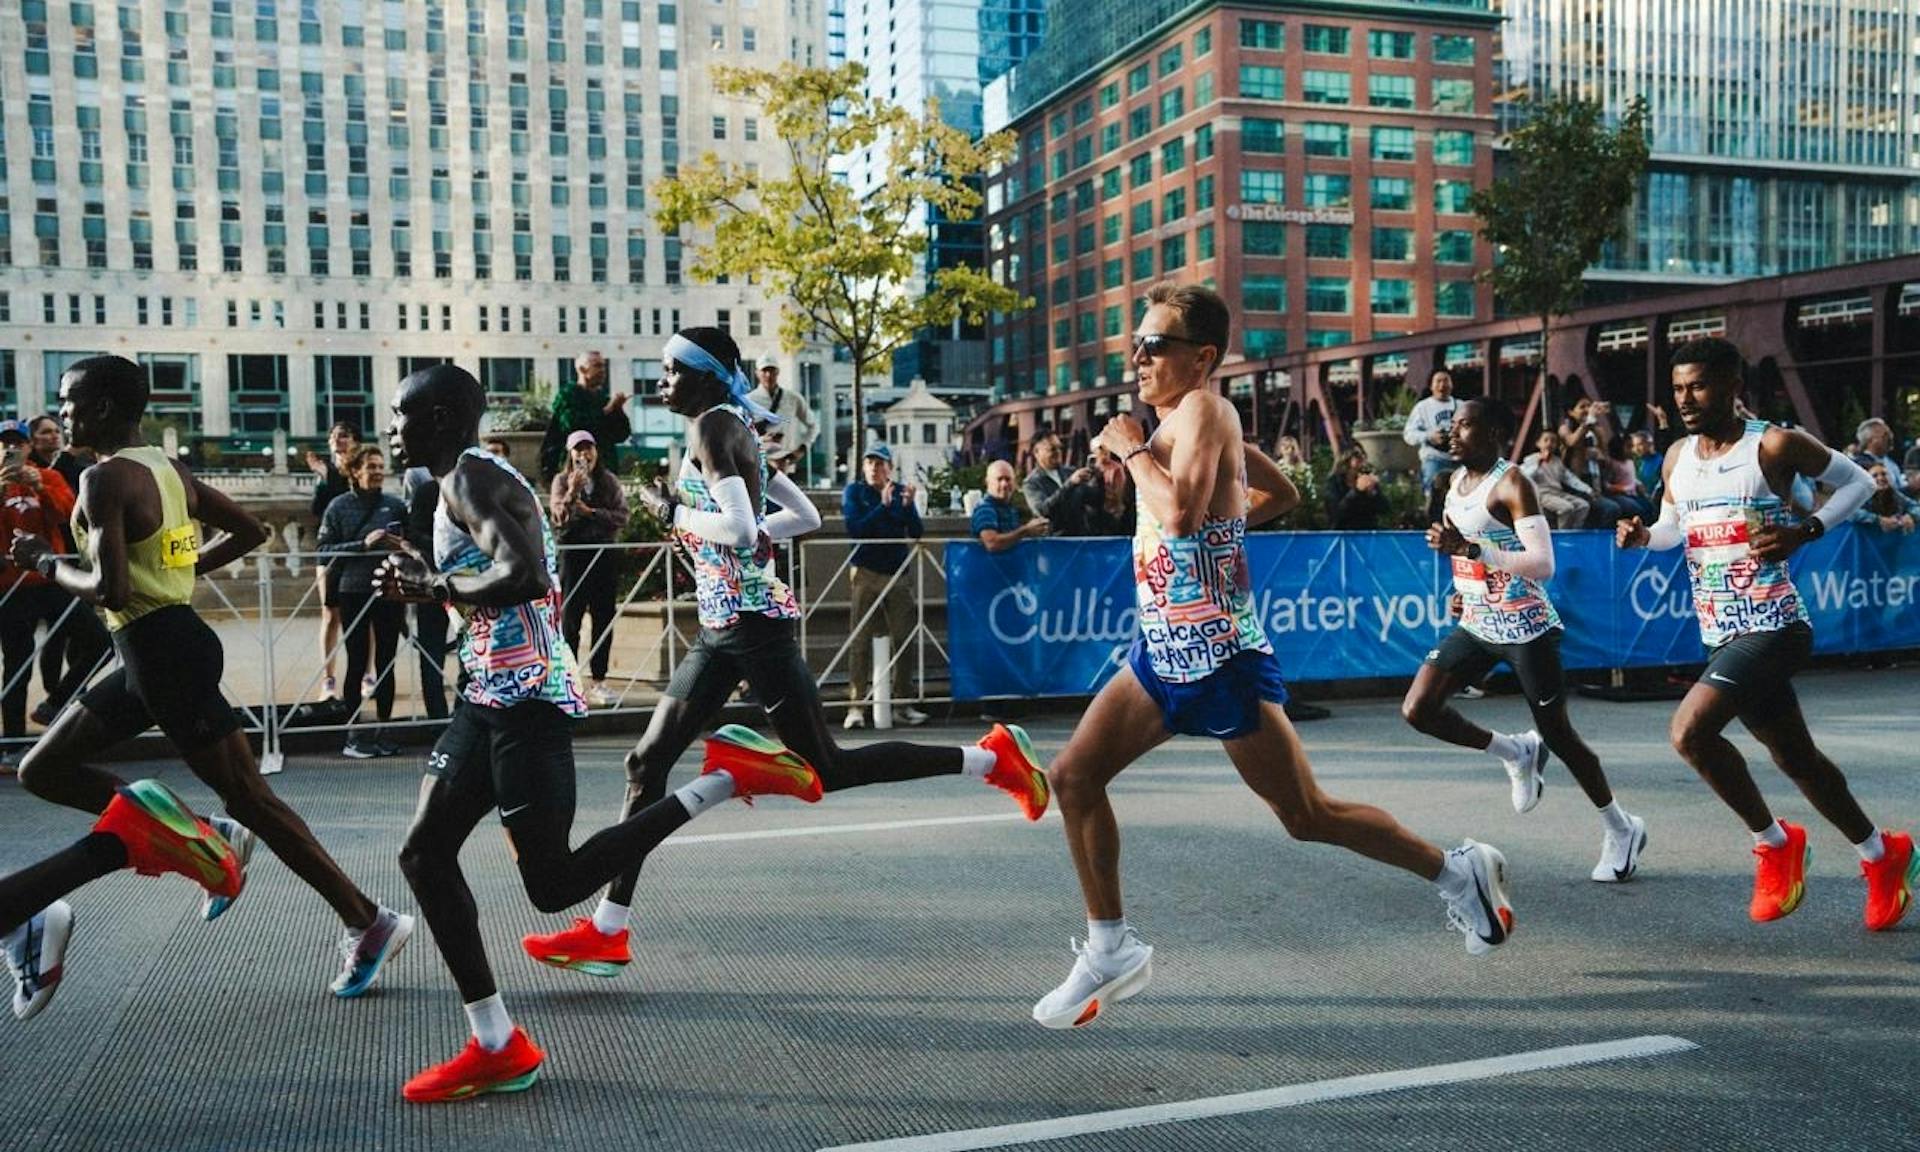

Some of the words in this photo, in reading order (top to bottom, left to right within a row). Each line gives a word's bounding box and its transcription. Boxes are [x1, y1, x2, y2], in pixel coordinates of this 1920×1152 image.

[1242, 204, 1264, 221] The
[1265, 205, 1314, 226] Chicago
[1315, 207, 1354, 225] School
[1695, 525, 1738, 541] TURA
[1811, 570, 1920, 610] Water
[1149, 617, 1231, 644] CHICAGO
